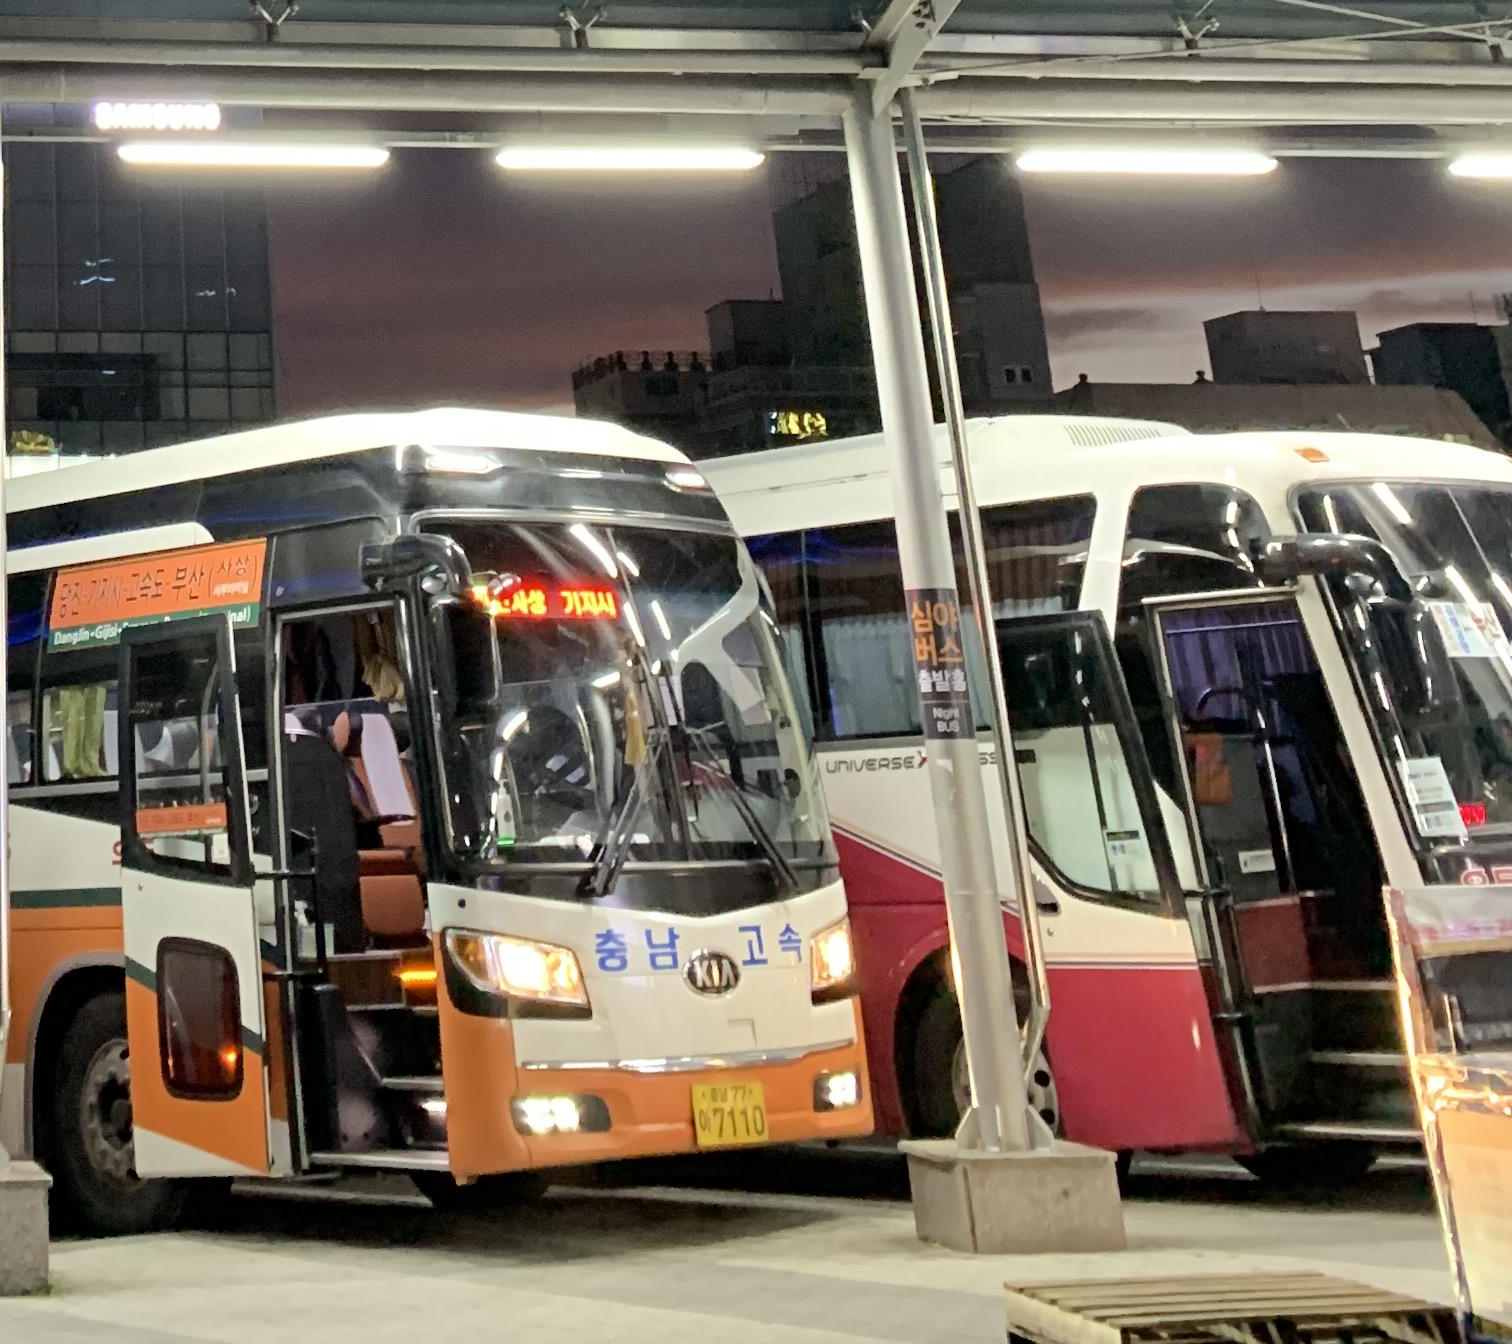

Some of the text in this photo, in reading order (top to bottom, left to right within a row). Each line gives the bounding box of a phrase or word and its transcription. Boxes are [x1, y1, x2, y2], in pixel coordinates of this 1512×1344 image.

[911, 600, 959, 633] 심야
[915, 636, 964, 666] 버스
[825, 755, 915, 773] UNIVERSE
[595, 923, 803, 972] 충남 고속
